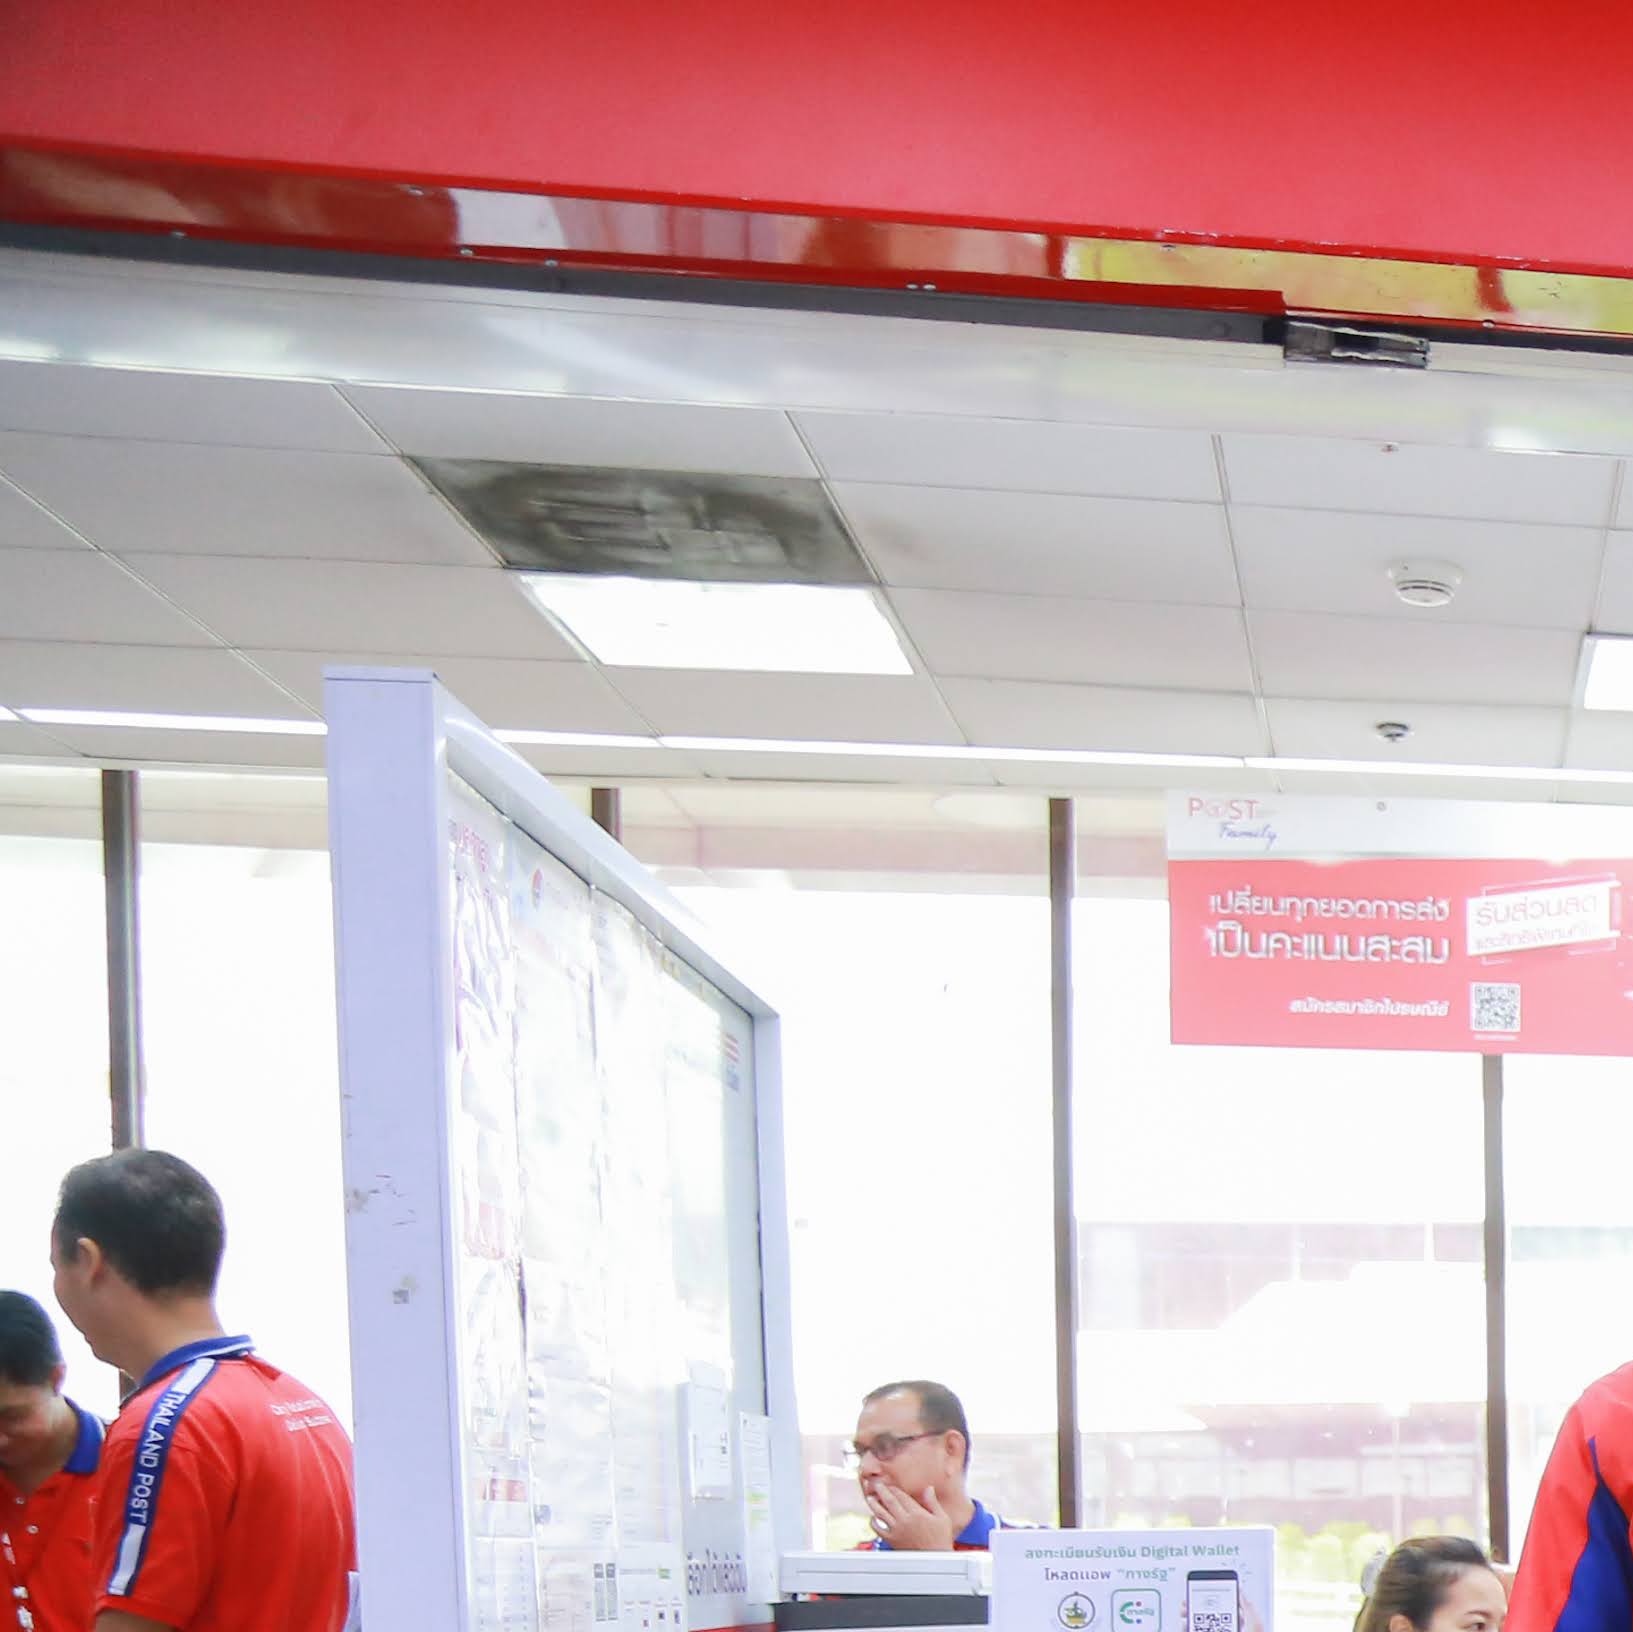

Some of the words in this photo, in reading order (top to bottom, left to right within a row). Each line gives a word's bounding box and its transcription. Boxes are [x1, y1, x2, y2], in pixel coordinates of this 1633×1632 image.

[1209, 885, 1450, 924] เปลี่ยนทุกยอดการส่ง
[1204, 920, 1449, 965] เป็นคะแนนสะสม
[138, 1388, 189, 1468] THAILAND
[130, 1471, 156, 1524] POST
[1025, 1544, 1136, 1562] ลงทะเบียนรับเงิน
[1140, 1545, 1189, 1561] Digital
[1193, 1545, 1240, 1559] Wallet
[1045, 1566, 1111, 1582] โหลดแอพ
